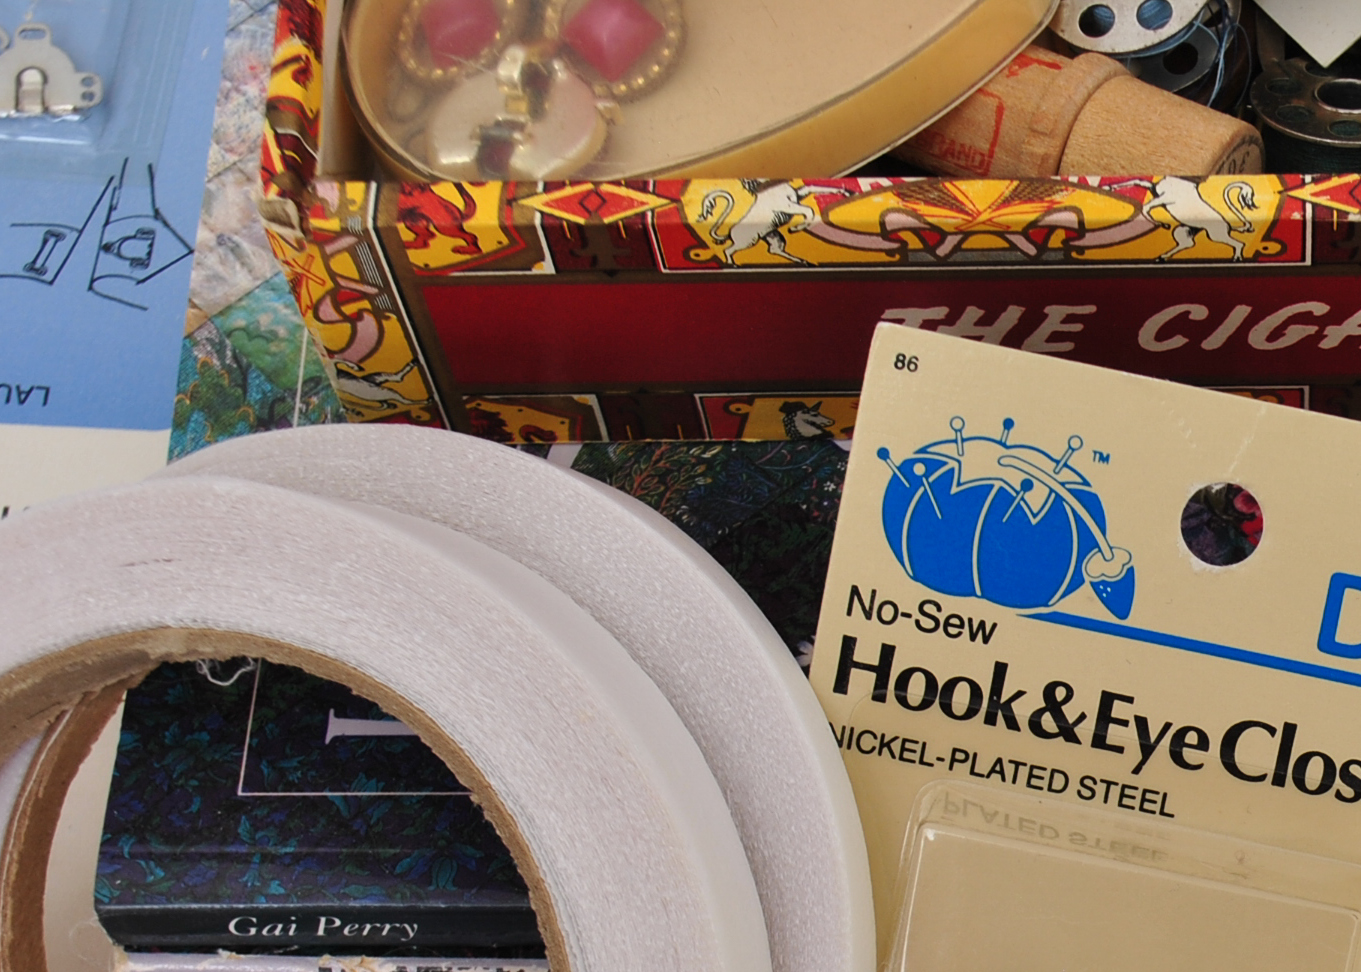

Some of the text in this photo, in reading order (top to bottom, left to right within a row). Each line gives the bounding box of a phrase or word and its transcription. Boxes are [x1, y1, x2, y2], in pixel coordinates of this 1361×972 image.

[881, 304, 1098, 352] THE
[893, 352, 919, 373] 86
[845, 584, 998, 645] No-Sew
[828, 721, 1176, 819] NICKEL-PLATED STEEL
[227, 915, 419, 941] Gai Perry
